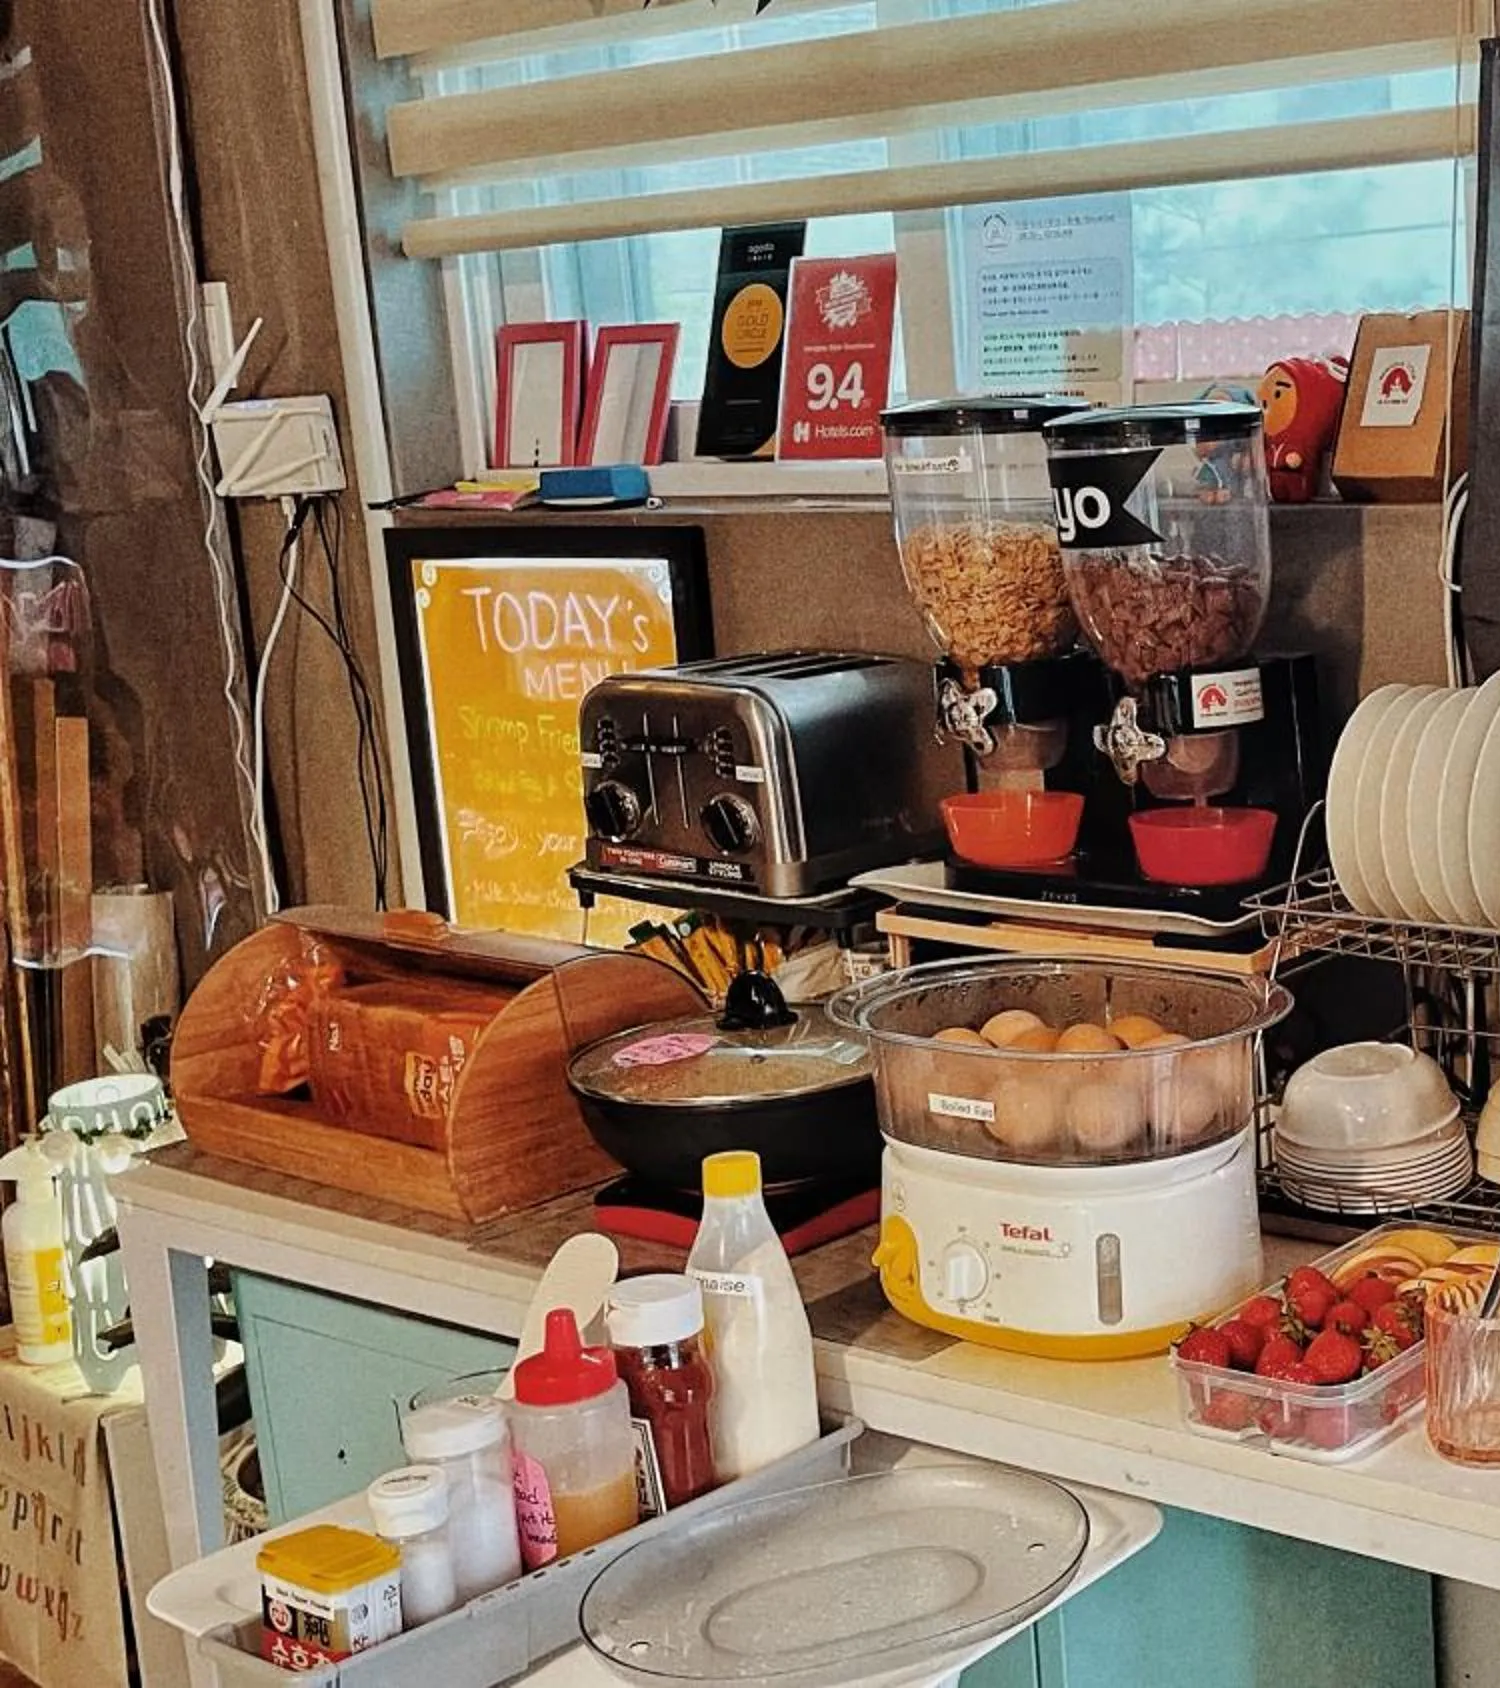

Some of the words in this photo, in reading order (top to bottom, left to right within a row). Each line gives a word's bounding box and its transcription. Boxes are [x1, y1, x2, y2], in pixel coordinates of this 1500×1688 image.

[806, 361, 865, 411] 9.4
[815, 422, 876, 440] Hotels.com
[1000, 1222, 1054, 1242] Tefal
